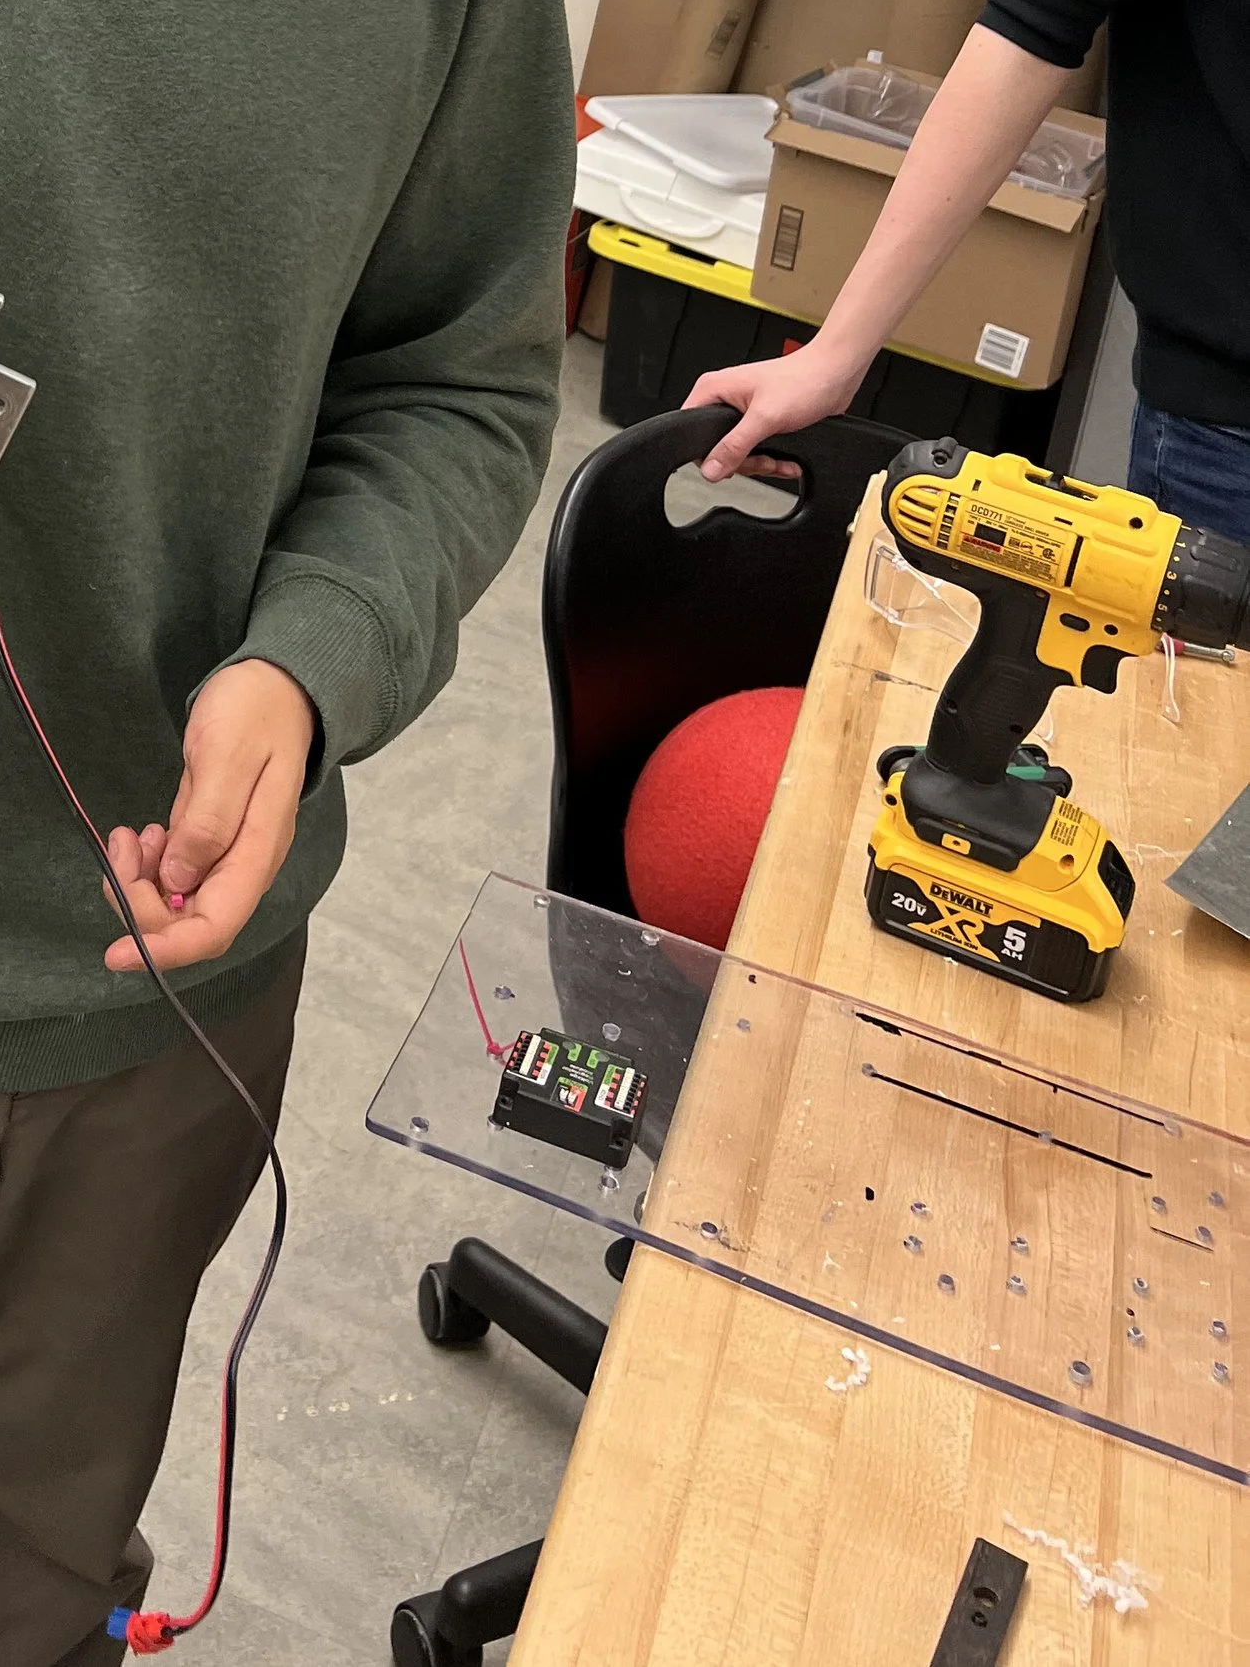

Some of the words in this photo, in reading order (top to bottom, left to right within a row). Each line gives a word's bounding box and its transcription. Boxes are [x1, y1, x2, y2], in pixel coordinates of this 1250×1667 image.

[971, 504, 1002, 521] DCD771
[1166, 570, 1177, 581] 3
[1157, 602, 1168, 613] 5
[930, 928, 962, 946] LITHIUM
[1003, 926, 1026, 952] 5
